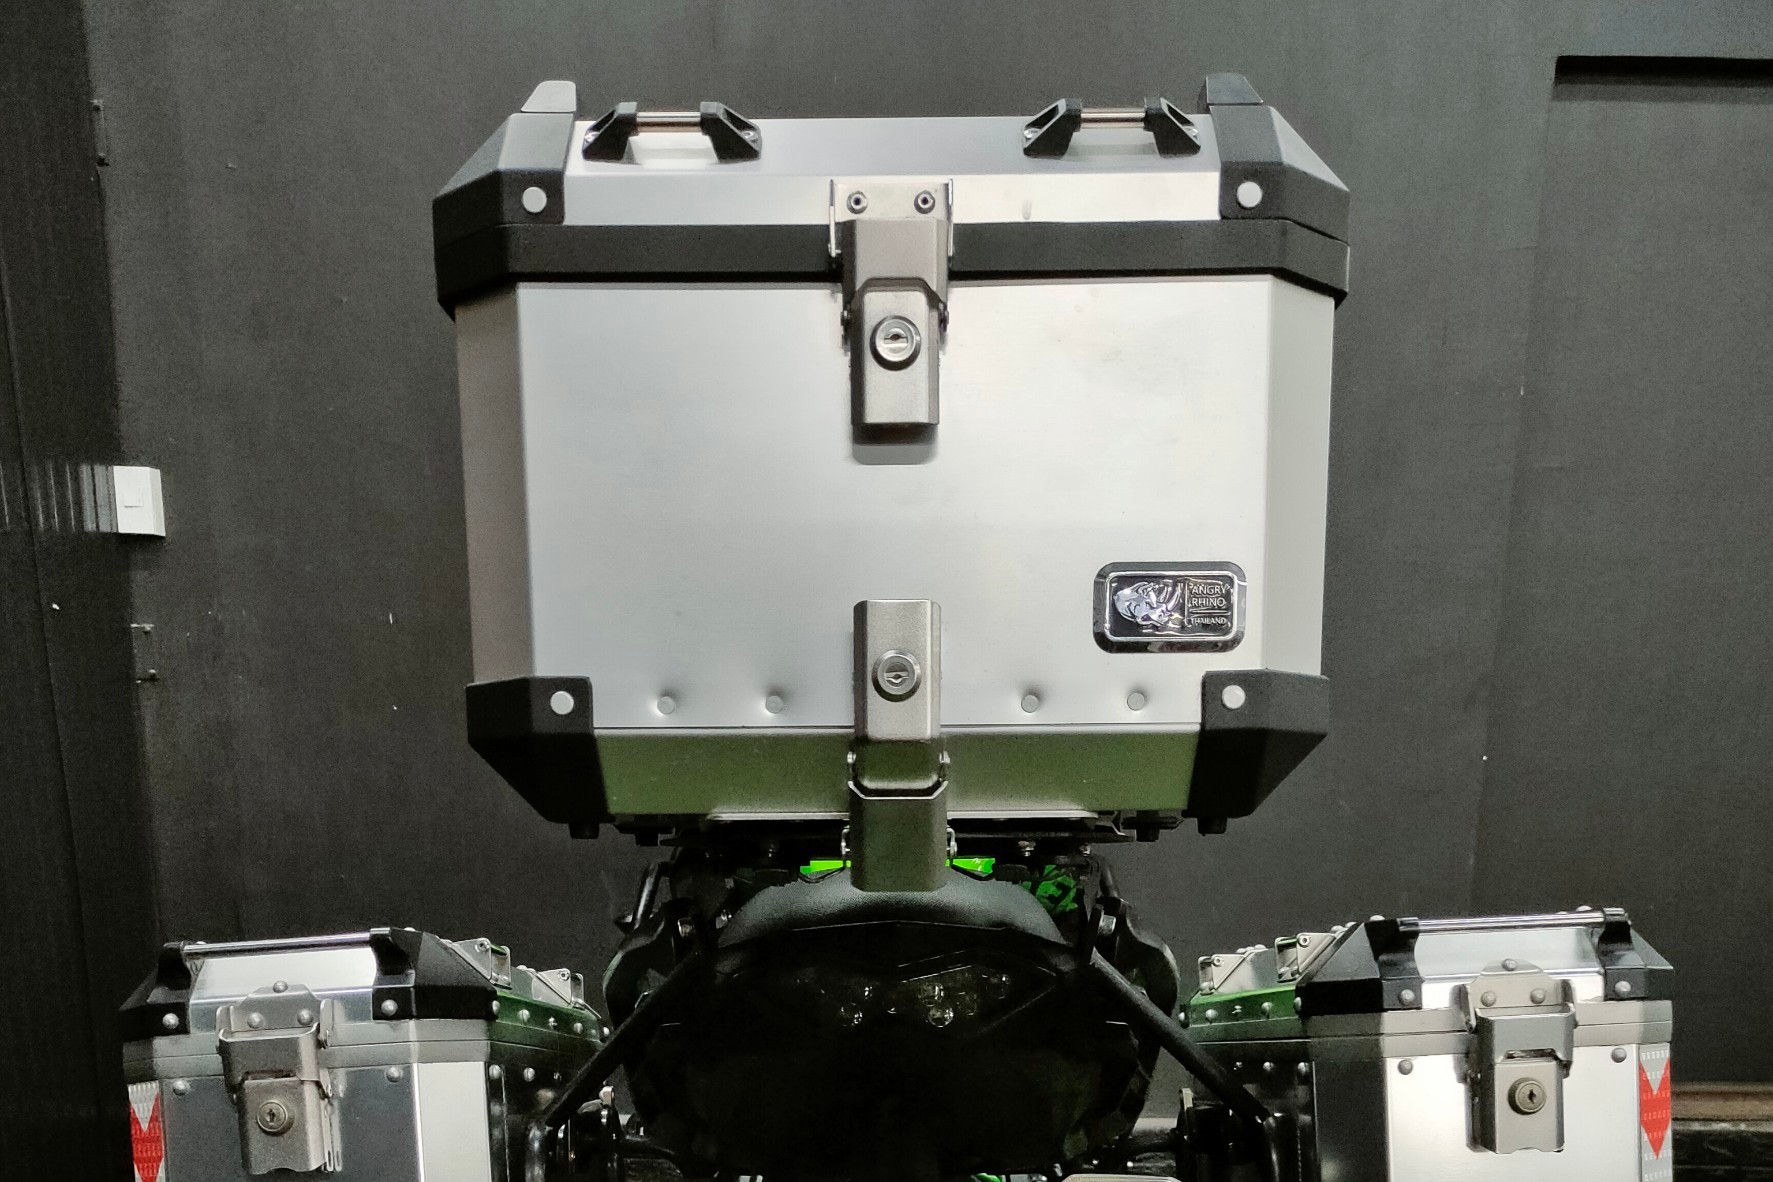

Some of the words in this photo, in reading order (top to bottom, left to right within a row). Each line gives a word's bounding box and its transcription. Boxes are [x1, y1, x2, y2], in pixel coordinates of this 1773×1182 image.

[1191, 584, 1227, 595] ANGRY
[1191, 597, 1225, 607] RHINO
[1190, 616, 1227, 625] THAILAND
